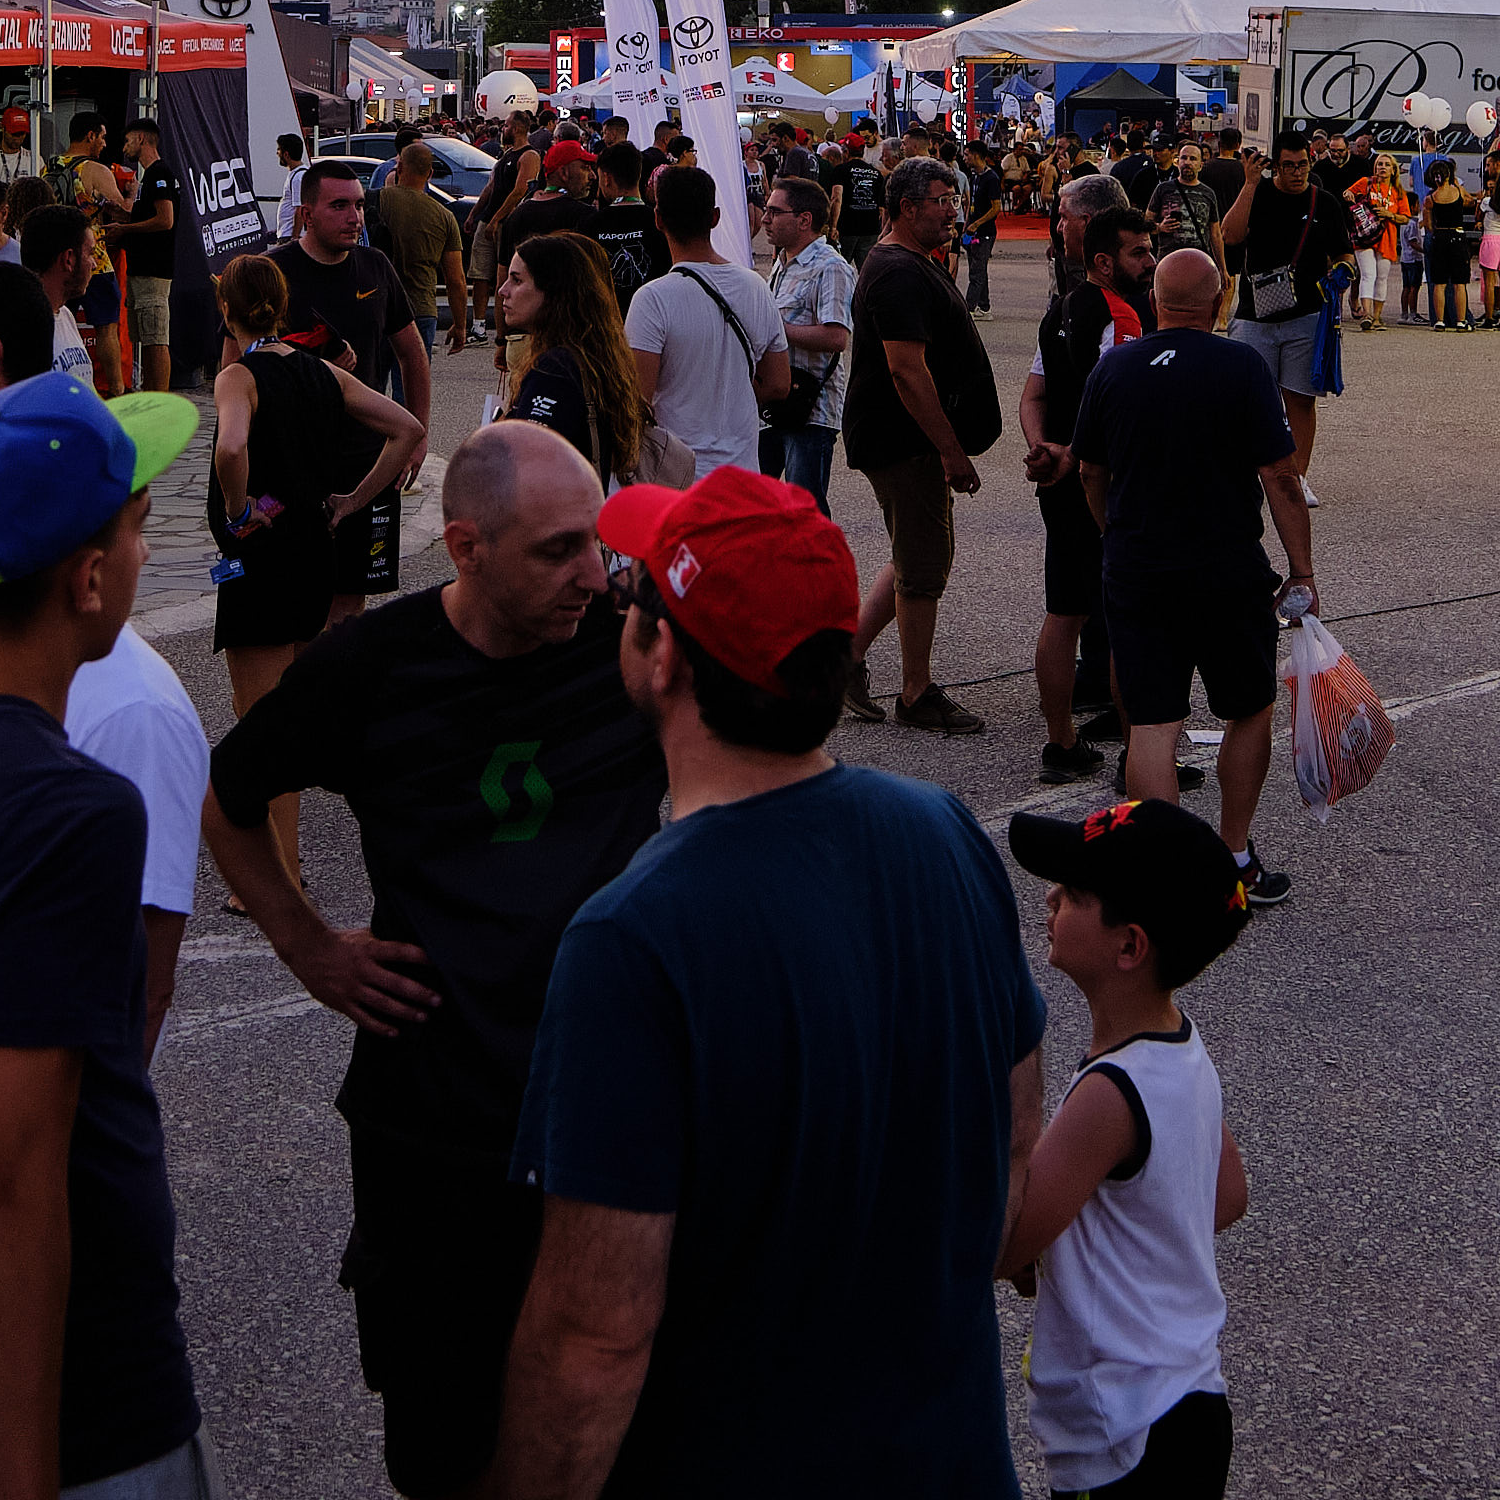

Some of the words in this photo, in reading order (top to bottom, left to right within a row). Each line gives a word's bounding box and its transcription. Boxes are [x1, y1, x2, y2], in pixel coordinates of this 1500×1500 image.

[28, 17, 93, 53] MECHANDISE
[110, 24, 145, 57] WRC
[745, 28, 784, 39] EKO
[754, 94, 784, 105] EKO
[188, 157, 255, 216] WRC
